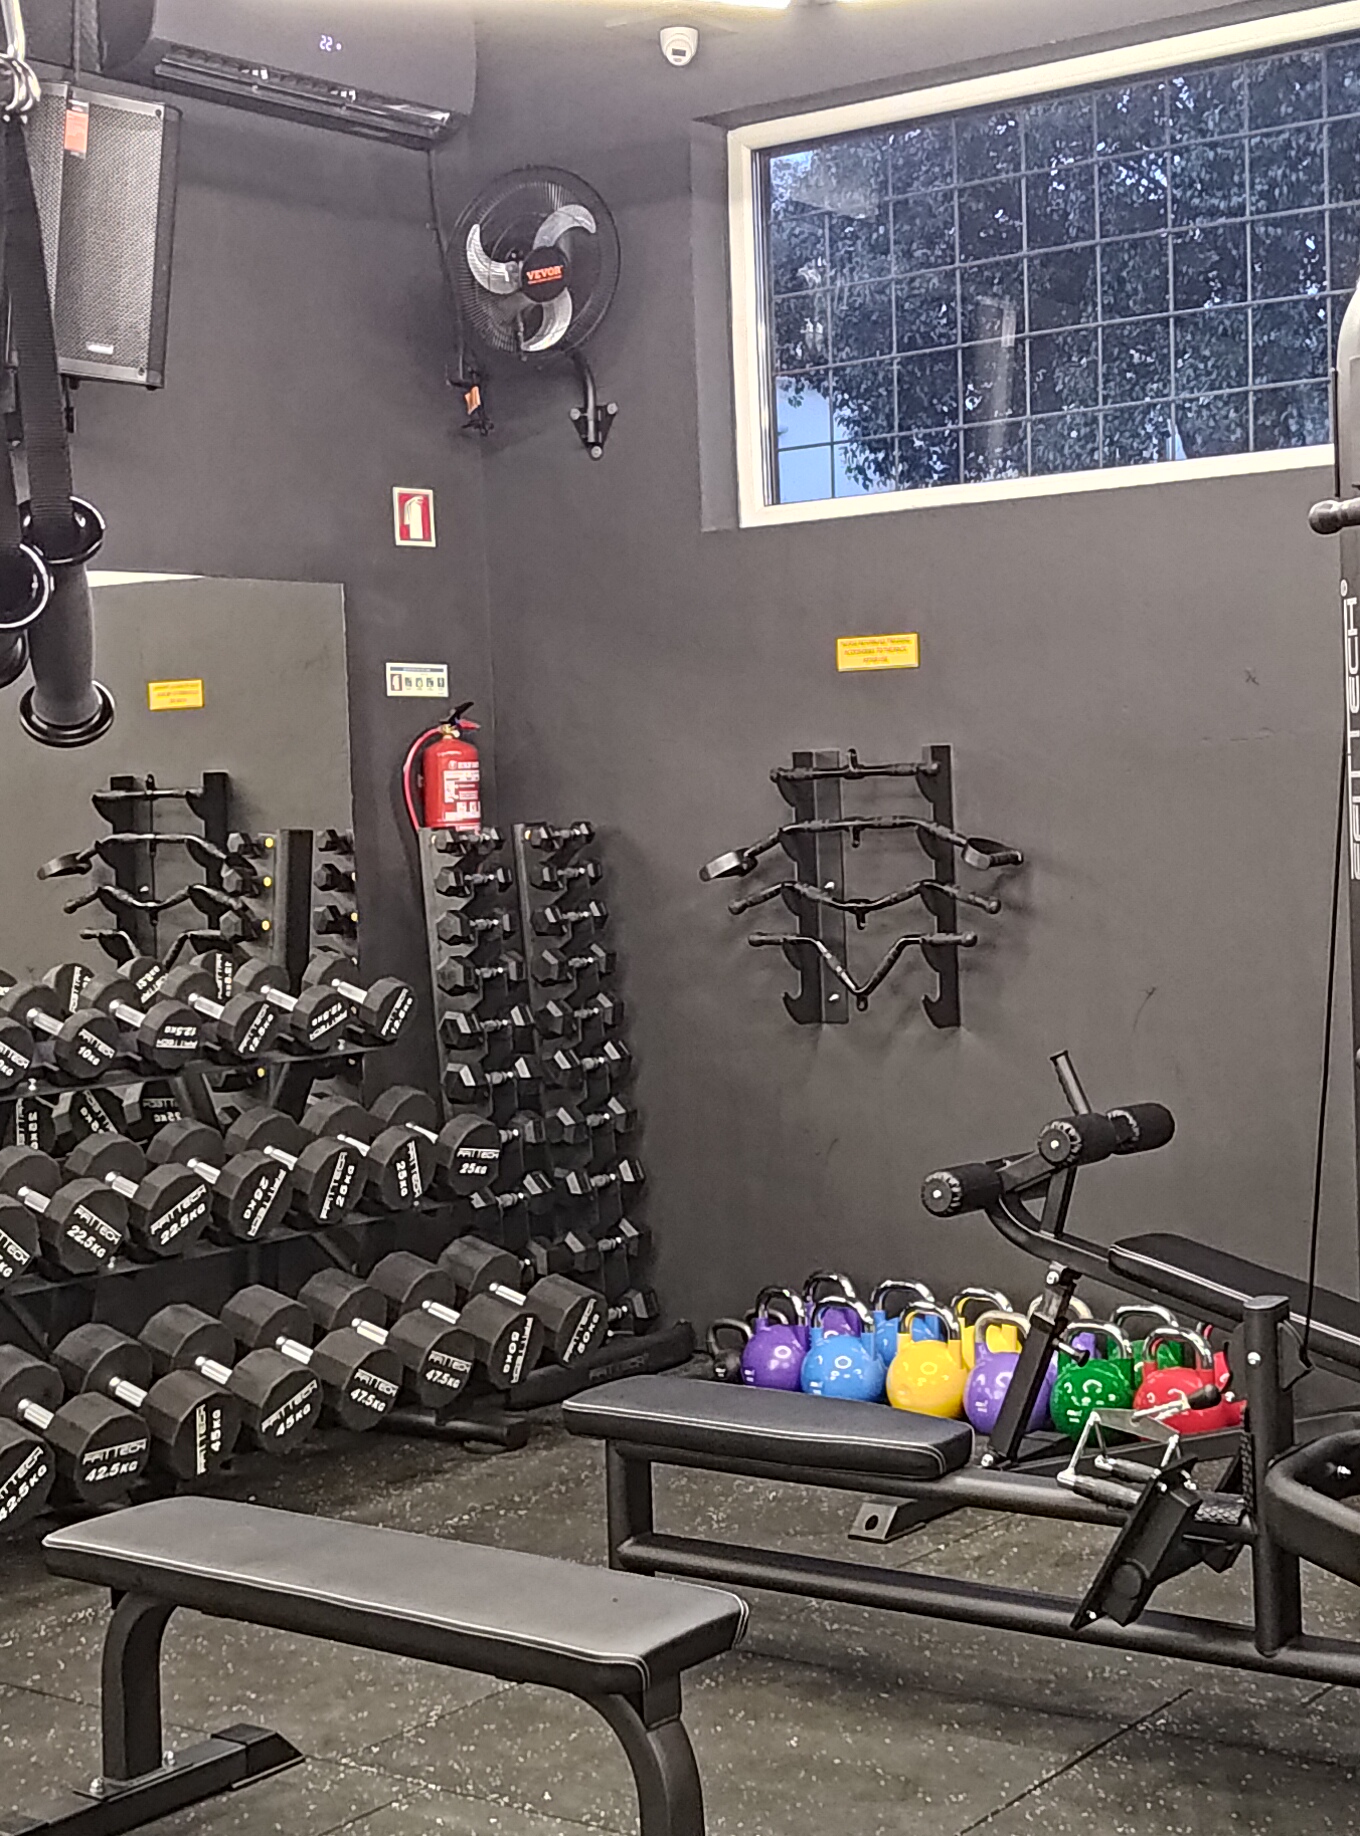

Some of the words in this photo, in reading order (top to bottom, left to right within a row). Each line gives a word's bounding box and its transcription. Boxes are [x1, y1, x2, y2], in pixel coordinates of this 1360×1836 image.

[526, 265, 562, 281] VEVOR
[78, 1046, 100, 1066] 10KG
[460, 1163, 488, 1175] 25KG
[160, 1203, 206, 1246] 22.5KG
[66, 1224, 107, 1258] 22.5KG
[425, 1368, 460, 1389] 47.5KG
[350, 1388, 386, 1412] 47.5KG
[276, 1403, 311, 1437] 45KG
[85, 1460, 139, 1482] 42.5KG
